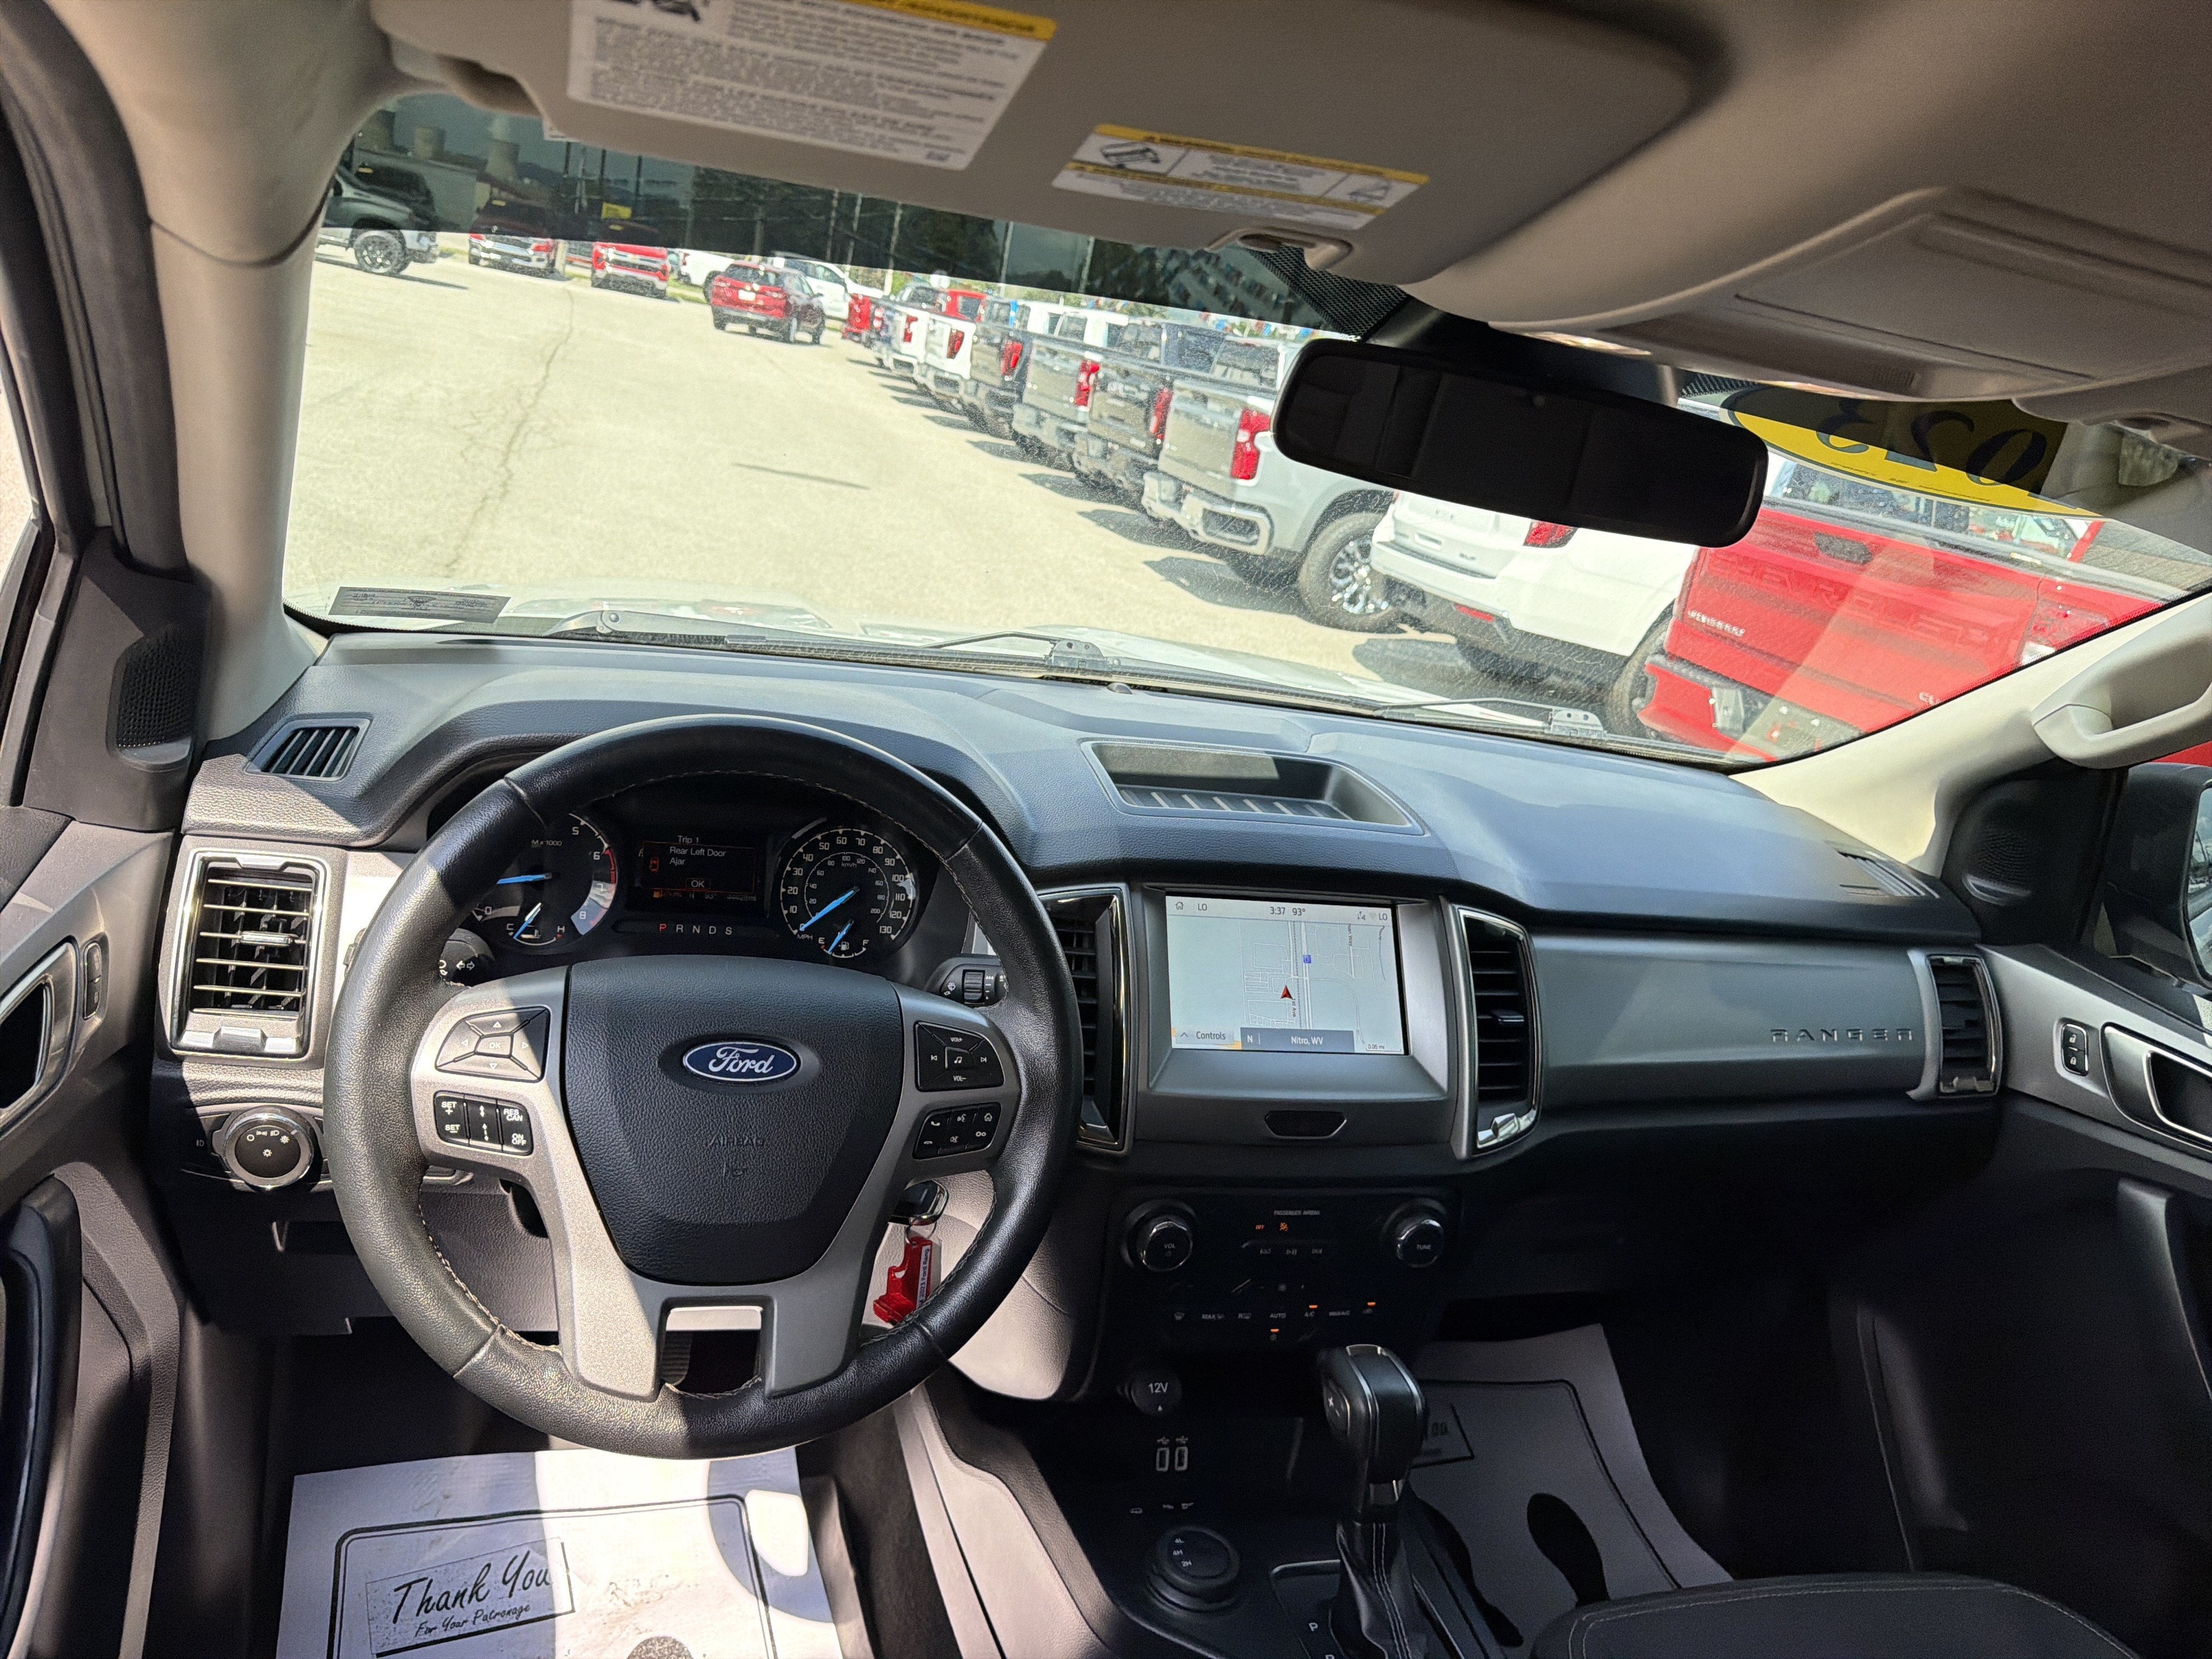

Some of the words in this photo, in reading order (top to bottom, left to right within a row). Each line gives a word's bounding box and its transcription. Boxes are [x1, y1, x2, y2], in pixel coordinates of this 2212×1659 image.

[572, 827, 579, 835] 5
[677, 835, 692, 844] Trip
[855, 838, 865, 846] 70
[593, 851, 600, 860] 6
[707, 849, 726, 857] Door
[669, 857, 685, 866] Ajar
[787, 887, 798, 895] 20
[789, 905, 797, 913] 10
[1198, 902, 1207, 911] LO
[579, 911, 586, 919] 8
[889, 911, 902, 919] 120
[1270, 907, 1285, 915] 3:37
[1292, 908, 1306, 916] 93°
[1378, 913, 1388, 921] LO
[676, 924, 684, 933] R
[725, 927, 732, 935] S
[879, 926, 892, 934] 130
[1196, 1031, 1226, 1041] Controls
[1770, 1029, 1912, 1042] RANGER
[1291, 1036, 1310, 1046] Nitro,
[1311, 1036, 1324, 1045] WV
[708, 1046, 775, 1074] Ford
[1148, 1382, 1169, 1393] 12V
[393, 1562, 492, 1624] Thank
[502, 1549, 552, 1599] You
[414, 1621, 438, 1638] For
[442, 1615, 469, 1632] Your
[472, 1604, 532, 1624] Patronage
[1308, 1622, 1319, 1632] P
